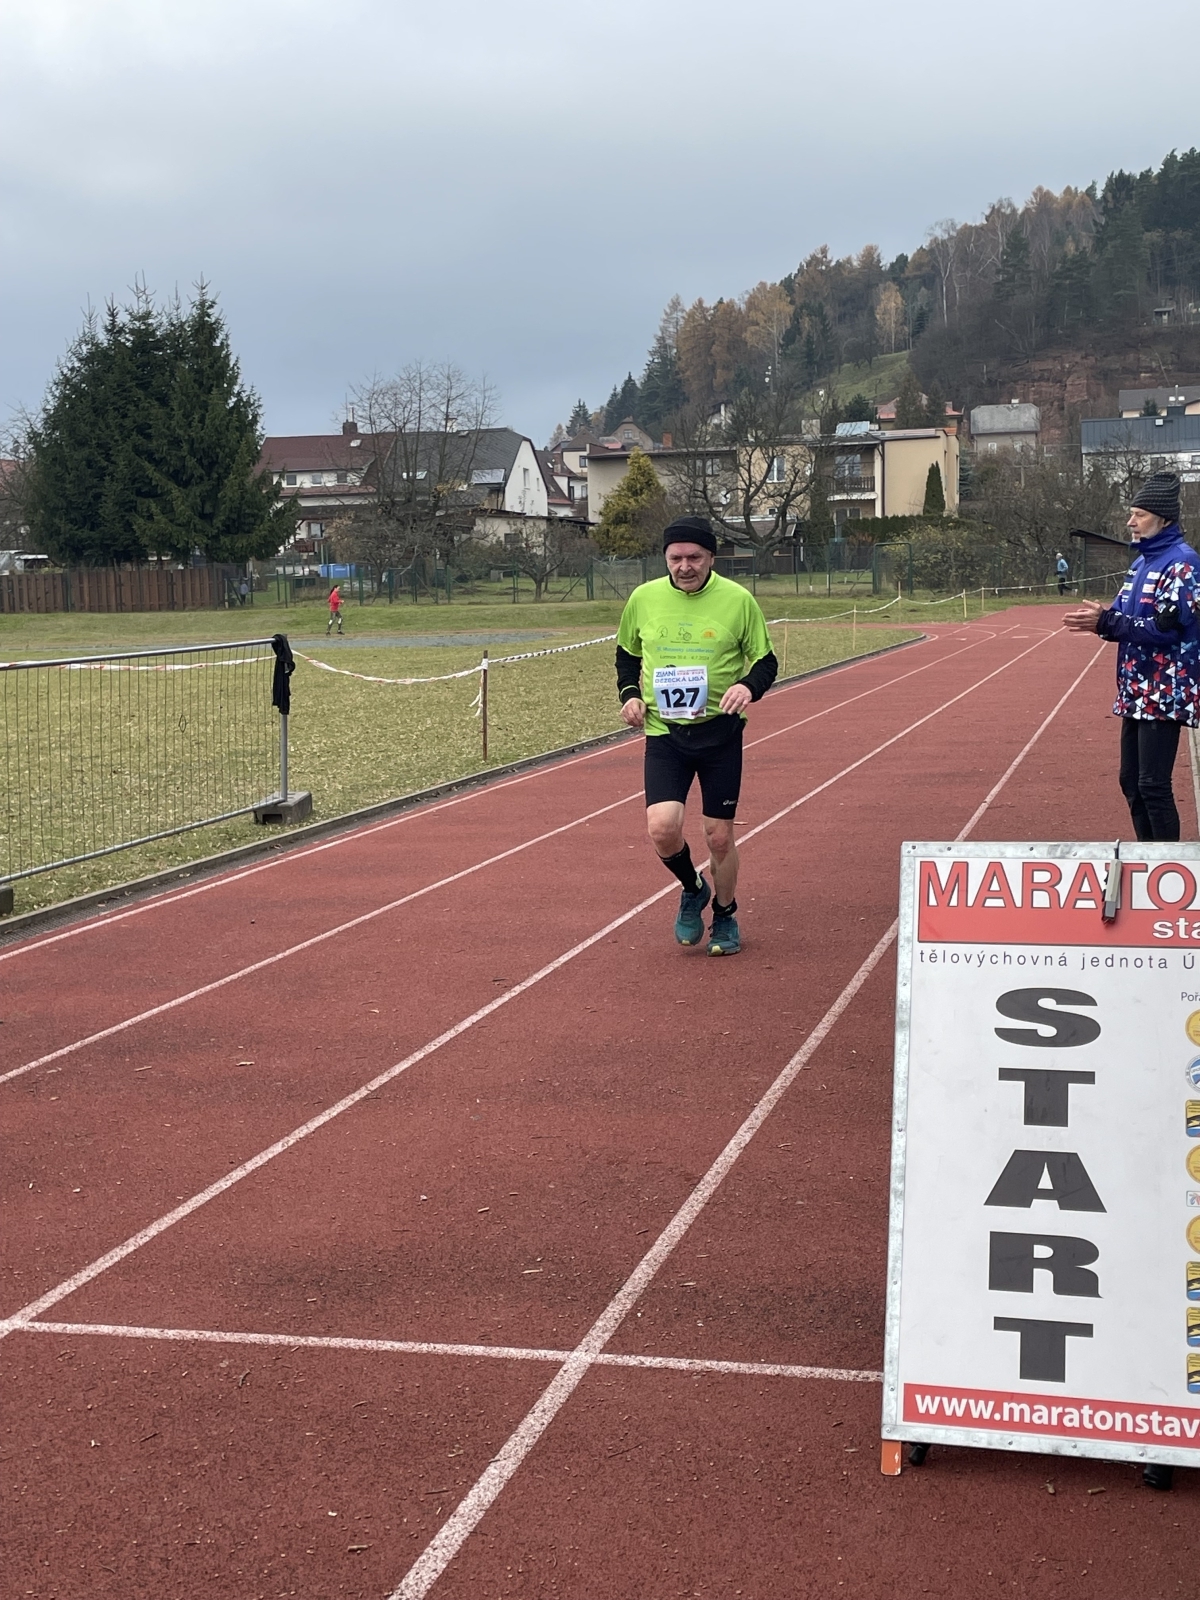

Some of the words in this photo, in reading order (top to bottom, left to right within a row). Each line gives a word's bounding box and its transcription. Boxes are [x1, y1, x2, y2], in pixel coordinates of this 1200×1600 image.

[660, 687, 700, 708] 127
[919, 950, 1068, 968] tělovýchovná
[1081, 953, 1168, 970] jednota
[1181, 991, 1200, 1002] Poř
[983, 987, 1108, 1384] START
[915, 1394, 1200, 1438] www.maratonstav
